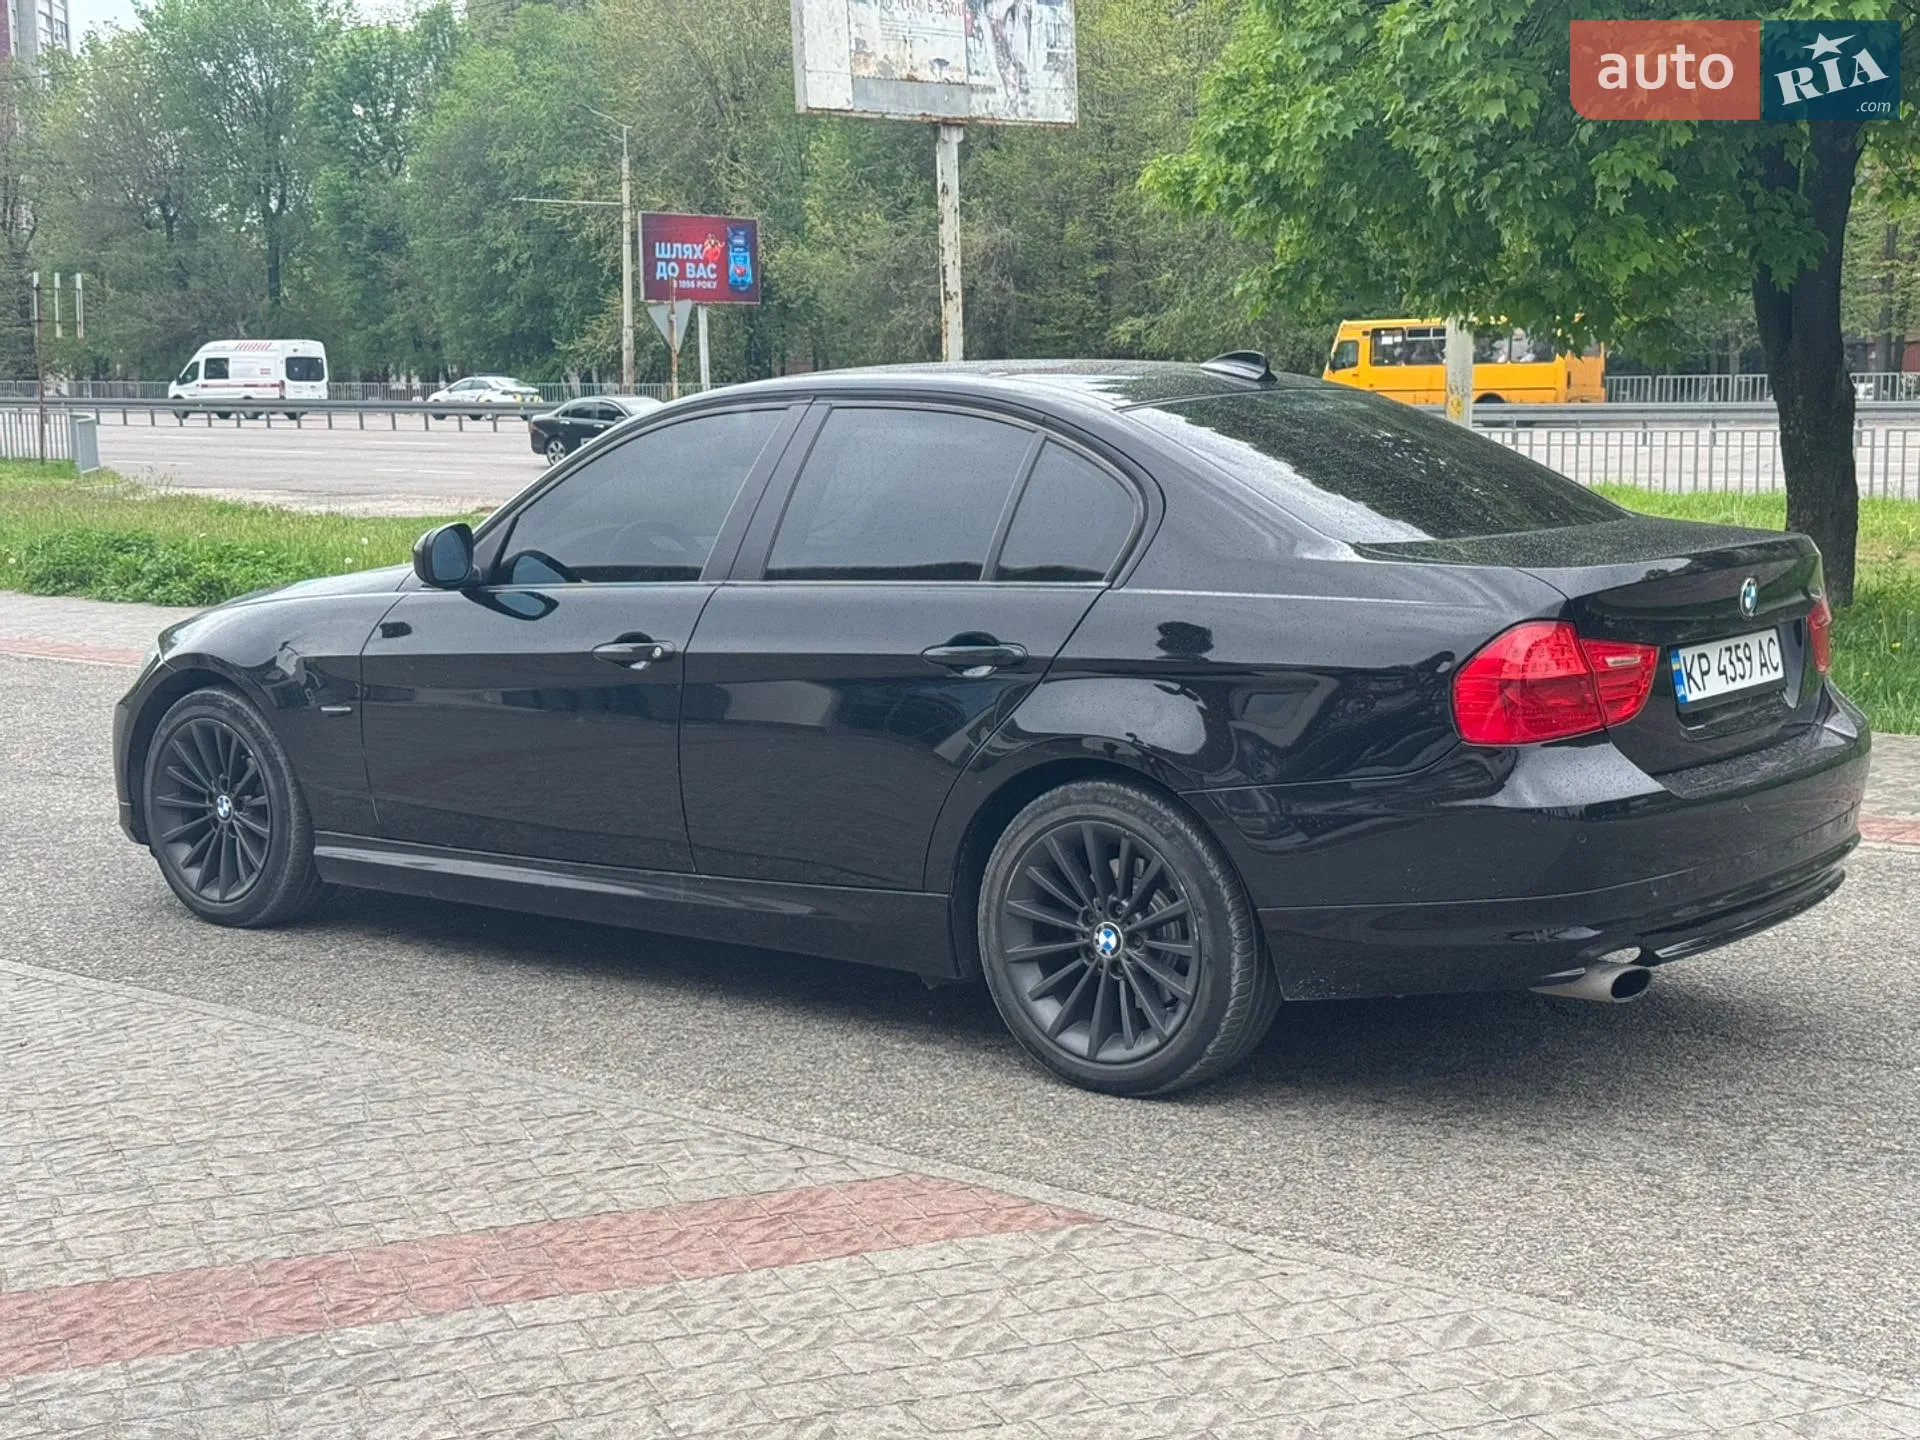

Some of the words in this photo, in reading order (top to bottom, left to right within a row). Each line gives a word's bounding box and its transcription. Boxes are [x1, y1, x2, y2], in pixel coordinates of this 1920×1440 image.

[655, 242, 703, 260] ШЛЯХ
[656, 262, 679, 280] ДО
[686, 263, 717, 279] ВАС
[1683, 652, 1711, 694] KP
[1717, 642, 1755, 685] 4359
[1758, 636, 1780, 677] AC
